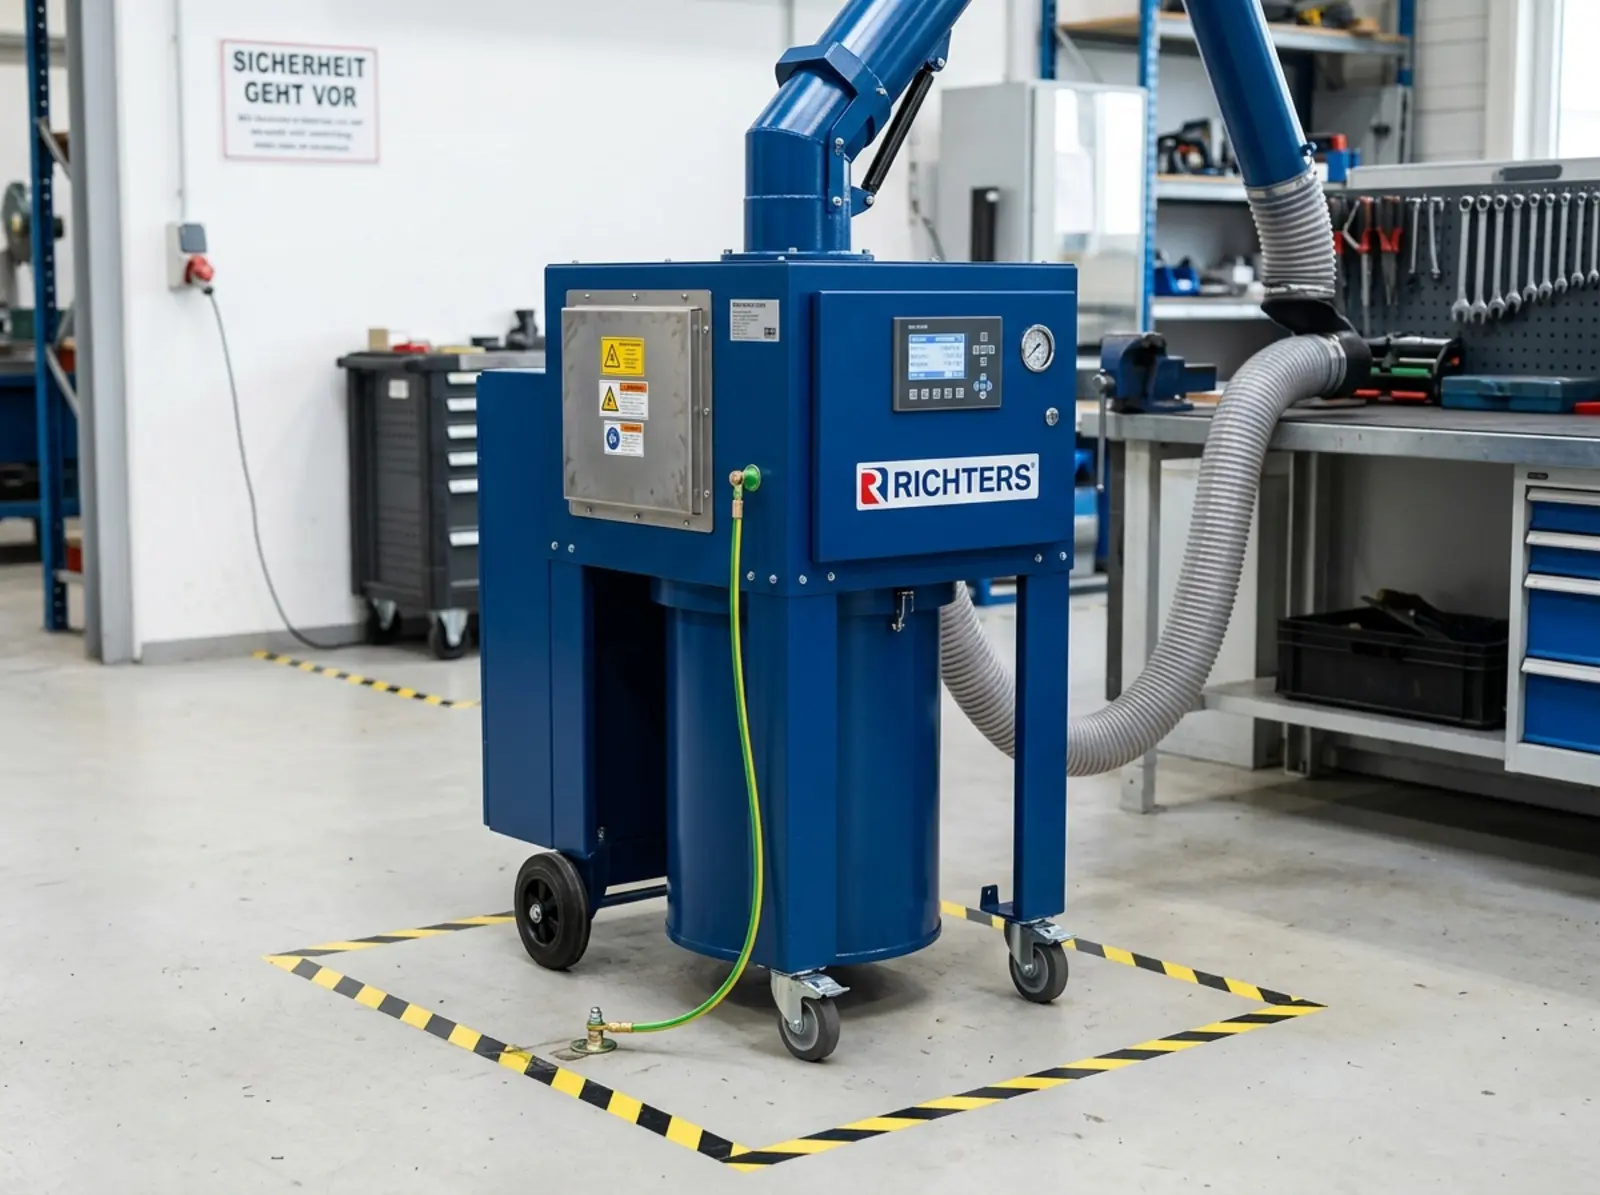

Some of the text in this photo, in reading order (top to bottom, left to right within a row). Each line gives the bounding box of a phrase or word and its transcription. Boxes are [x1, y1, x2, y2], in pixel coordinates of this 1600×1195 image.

[233, 50, 366, 78] SICHERHEIT
[244, 81, 357, 108] GEHT VOR
[894, 463, 1032, 499] RICHTERS
